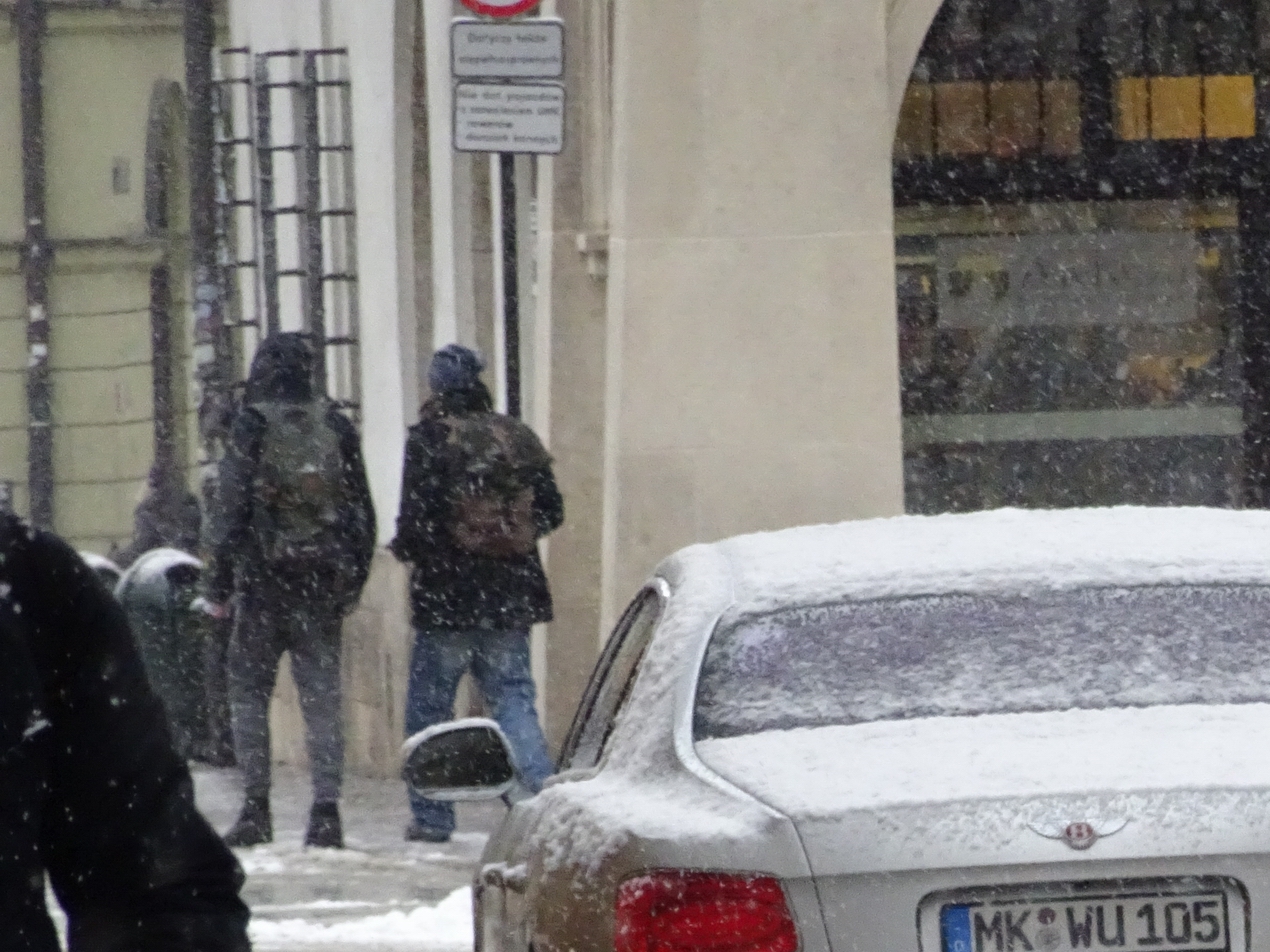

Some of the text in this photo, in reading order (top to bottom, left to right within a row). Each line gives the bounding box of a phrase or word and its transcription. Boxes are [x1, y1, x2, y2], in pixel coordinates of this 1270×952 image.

[973, 901, 1221, 952] MK WU 105
